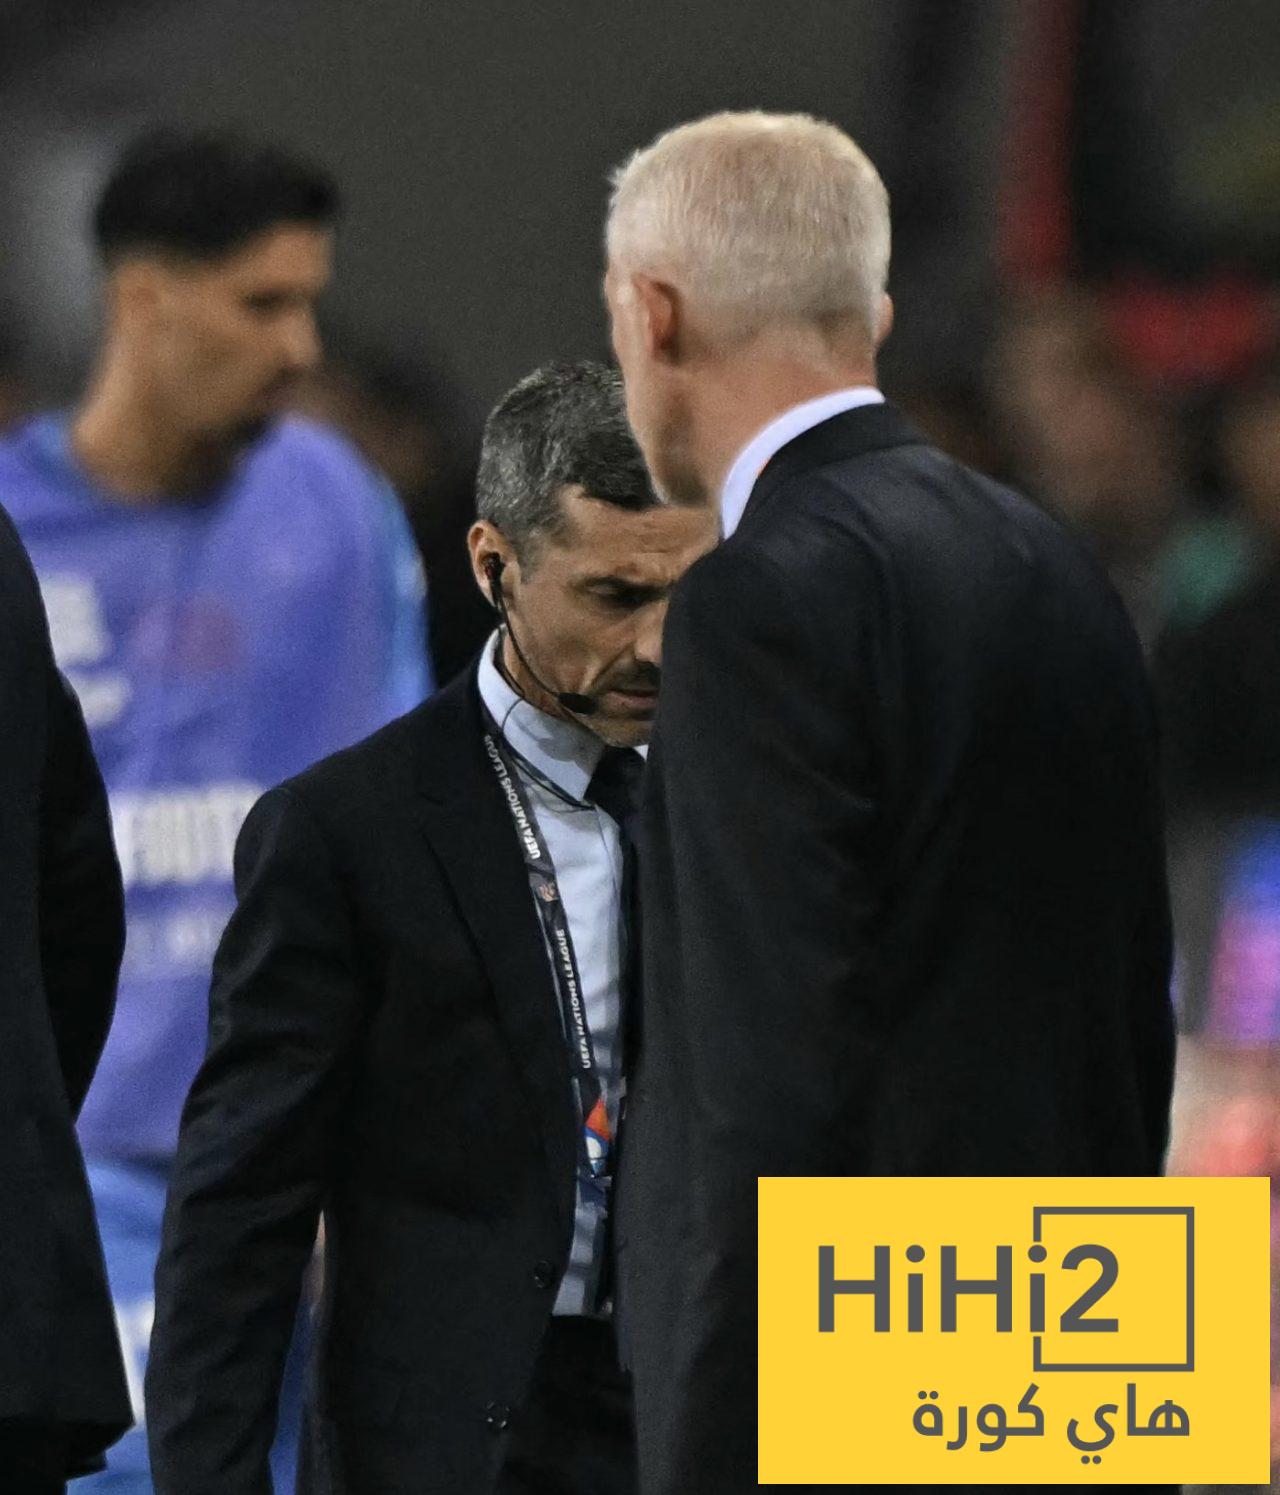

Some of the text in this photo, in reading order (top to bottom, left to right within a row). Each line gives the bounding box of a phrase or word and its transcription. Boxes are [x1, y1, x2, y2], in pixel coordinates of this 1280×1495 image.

[501, 777, 529, 830] NATIONS
[523, 828, 541, 860] UEFA
[556, 928, 591, 1069] UEFA NATIONS LEAGUE
